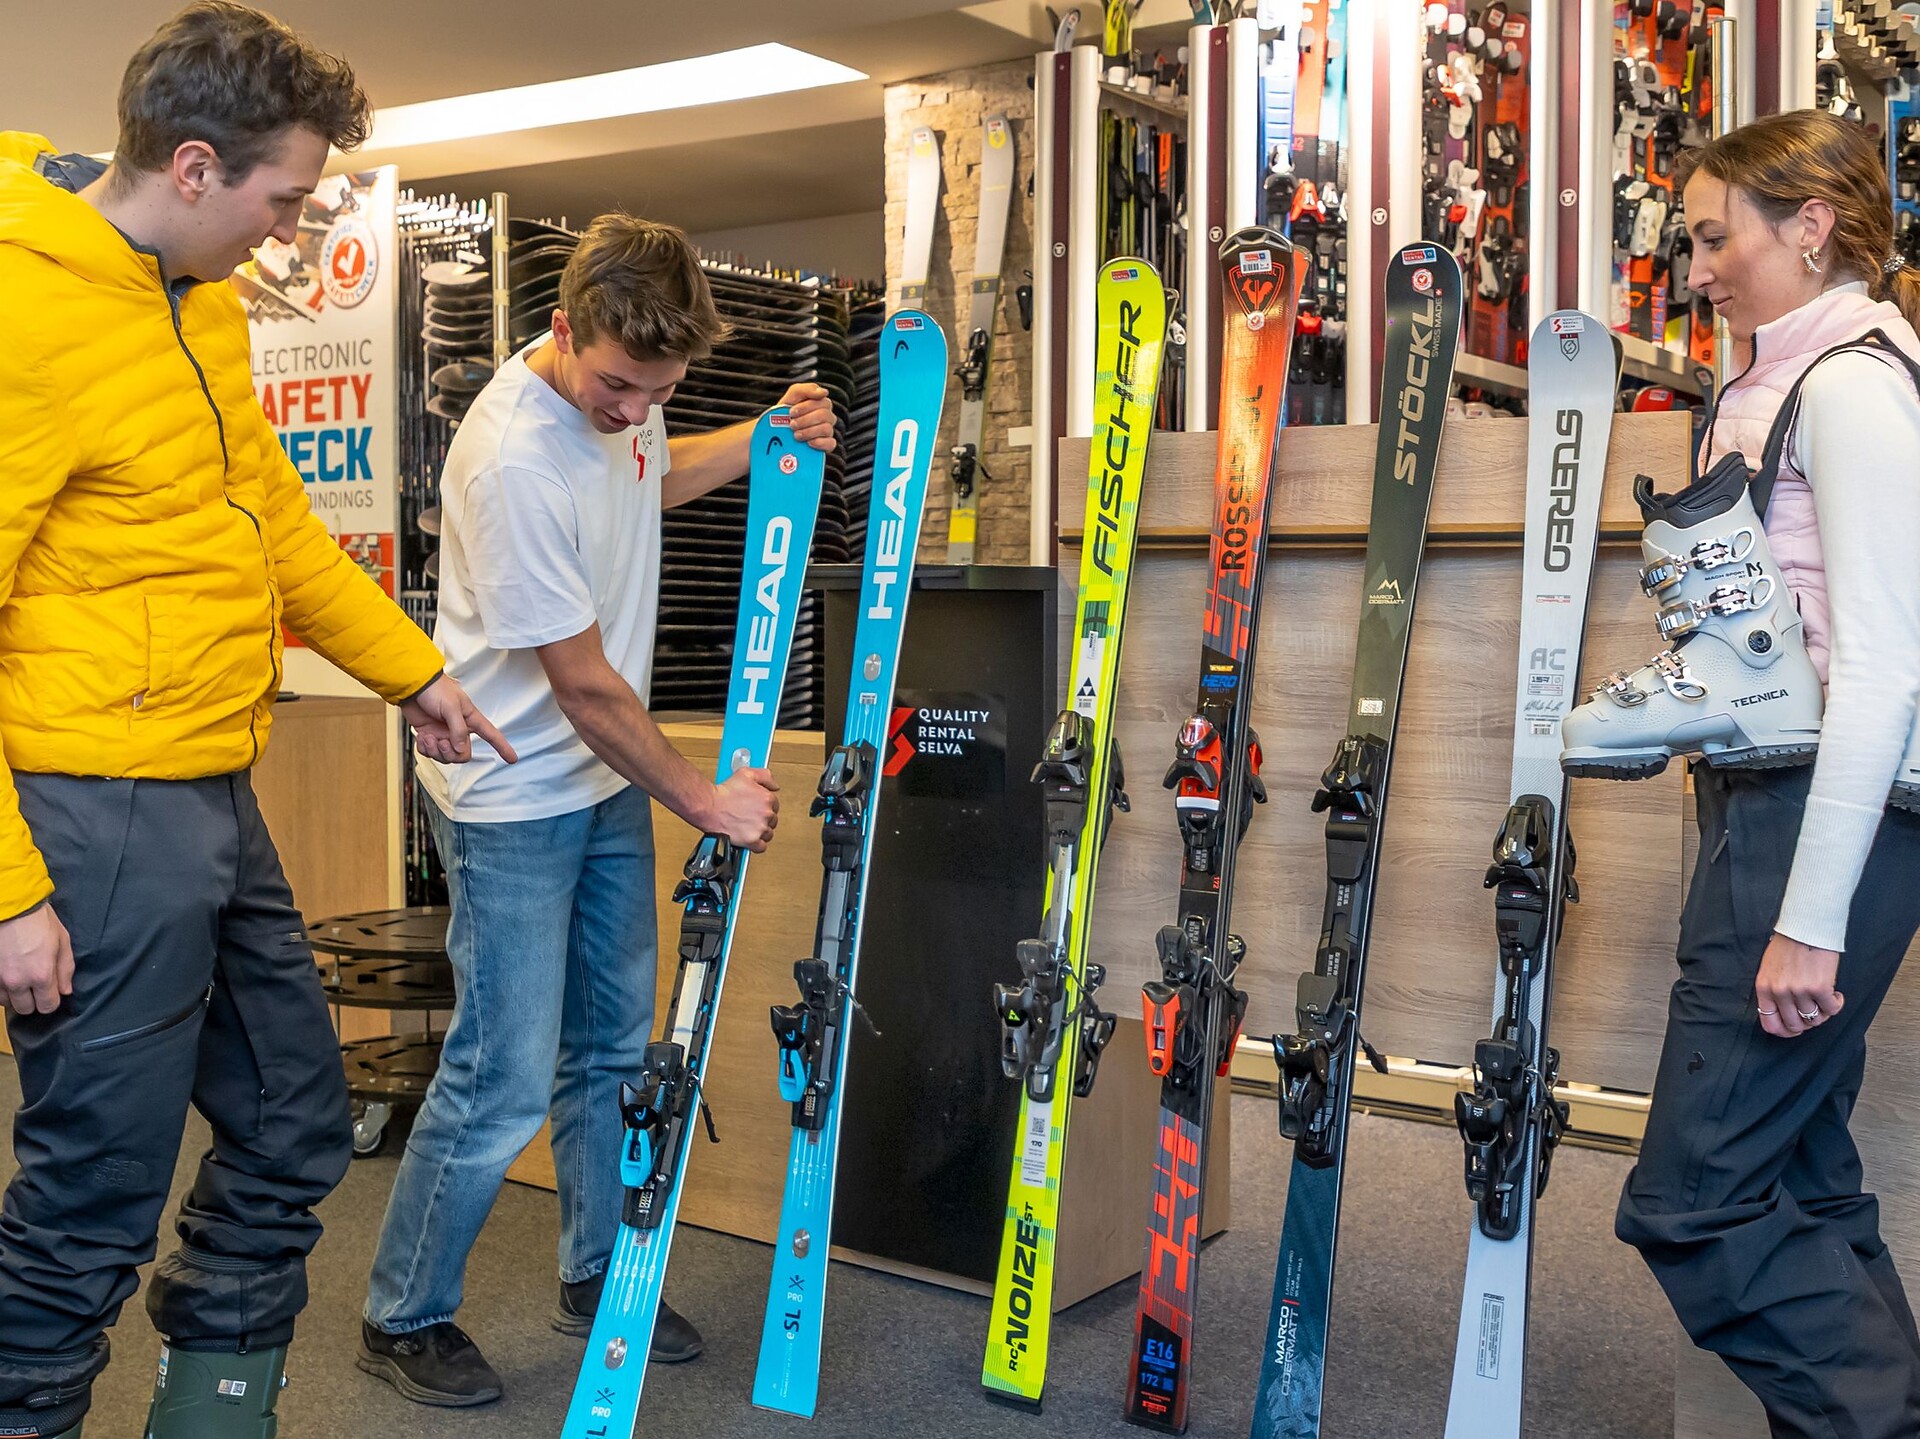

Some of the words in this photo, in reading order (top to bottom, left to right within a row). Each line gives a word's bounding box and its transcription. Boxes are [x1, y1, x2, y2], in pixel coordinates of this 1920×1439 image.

[1434, 297, 1444, 328] MADE
[251, 339, 373, 376] LECTRONIC
[1431, 328, 1442, 358] SWISS
[252, 373, 373, 428] AFETY
[1393, 298, 1435, 486] STÖCKL
[1093, 300, 1142, 578] FISCHER
[278, 426, 374, 484] ECK
[1543, 408, 1584, 573] STEREO
[866, 418, 919, 620] HEAD
[736, 515, 793, 715] HEAD
[1530, 647, 1567, 671] AC
[1730, 688, 1789, 708] TECNICA
[918, 707, 990, 723] QUALITY
[918, 725, 976, 740] RENTAL
[918, 741, 963, 756] SELVA
[786, 1291, 804, 1303] PRO
[1146, 1338, 1174, 1361] E16
[1274, 1305, 1290, 1365] MARCO
[1281, 1307, 1299, 1397] ODERMATT
[1141, 1372, 1159, 1388] 172
[591, 1405, 612, 1419] PRO
[0, 1426, 38, 1435] ECNICA
